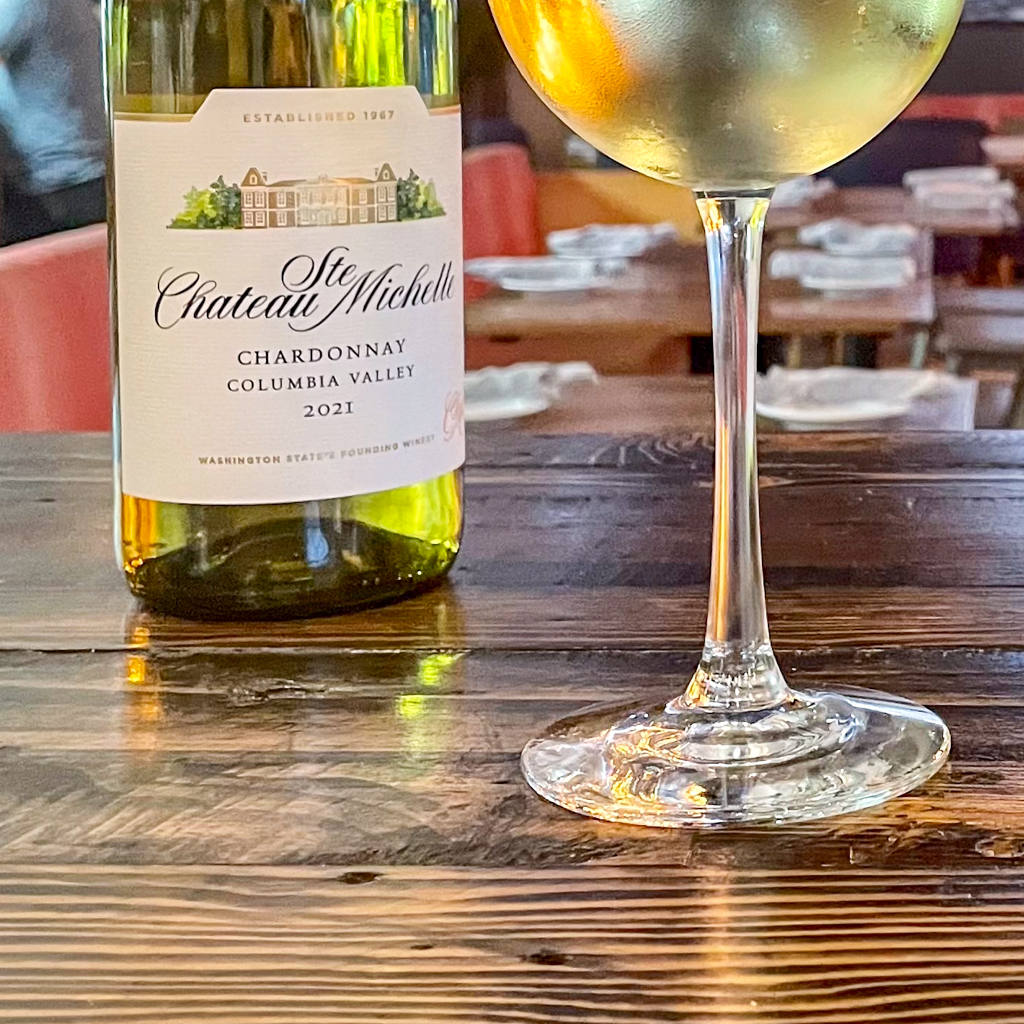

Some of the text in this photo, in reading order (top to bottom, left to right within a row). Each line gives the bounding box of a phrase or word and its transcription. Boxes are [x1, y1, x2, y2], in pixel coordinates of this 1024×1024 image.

[242, 109, 395, 124] ESTABLISHED 1967
[281, 245, 356, 293] Ste
[154, 266, 319, 330] Chateau
[237, 338, 407, 367] CHARDONNAY
[226, 363, 416, 393] COLUMBIA VALLEY
[302, 400, 355, 419] 2021
[197, 455, 282, 466] WASHINGTON
[340, 442, 399, 459] FOUNDING
